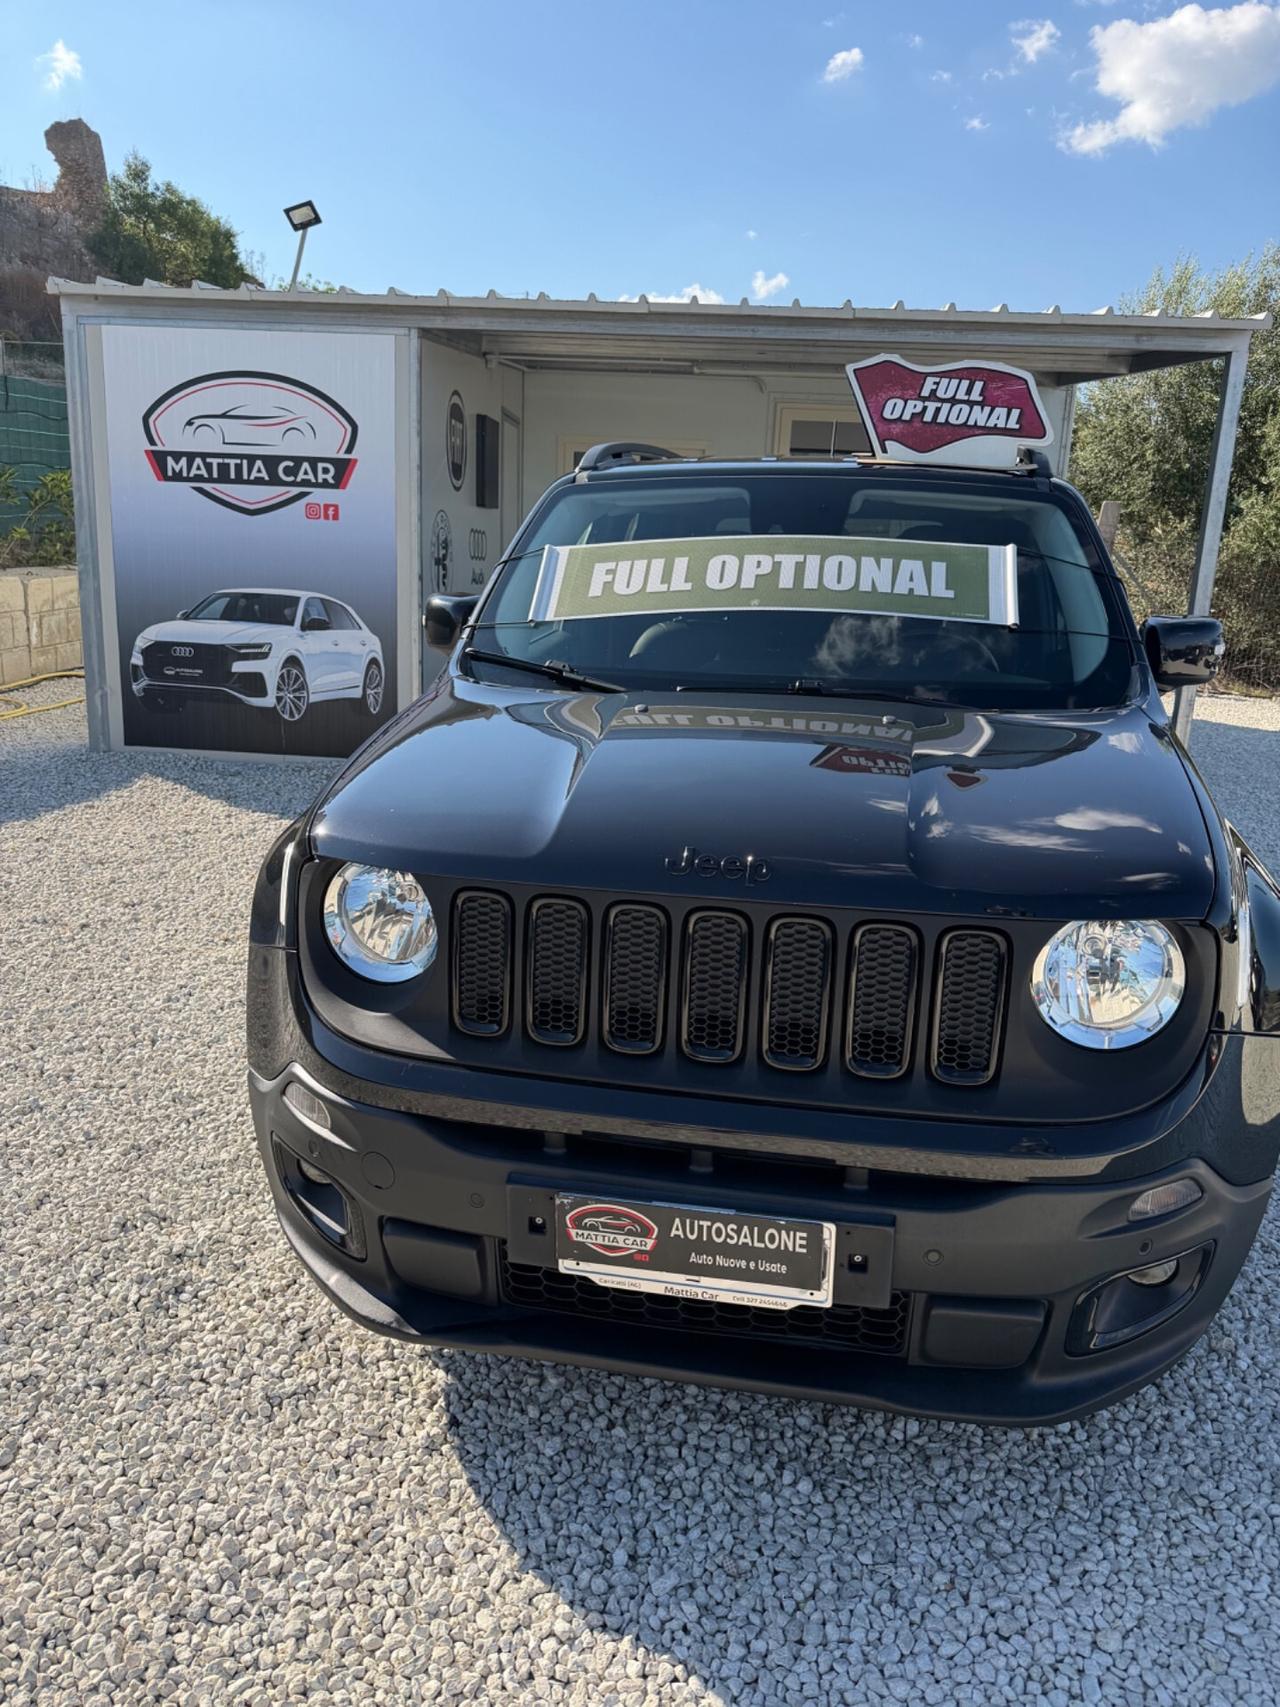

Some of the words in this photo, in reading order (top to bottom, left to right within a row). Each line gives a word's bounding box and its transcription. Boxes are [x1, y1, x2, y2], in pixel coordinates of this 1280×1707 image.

[921, 376, 985, 401] FULL
[883, 399, 1021, 429] OPTIONAL
[166, 454, 271, 482] MATTIA
[277, 459, 336, 485] CAR
[588, 556, 693, 597] FULL
[705, 553, 956, 600] OPTIONAL
[664, 845, 772, 886] Jeep
[575, 1231, 620, 1246] MATTIA
[623, 1239, 648, 1249] CAR
[669, 1217, 808, 1254] AUTOSALONE
[689, 1252, 713, 1265] Auto
[716, 1255, 747, 1270] Nuove
[749, 1261, 755, 1270] e
[758, 1259, 788, 1274] Usate
[664, 1285, 699, 1299] Mattia
[701, 1289, 720, 1301] Car
